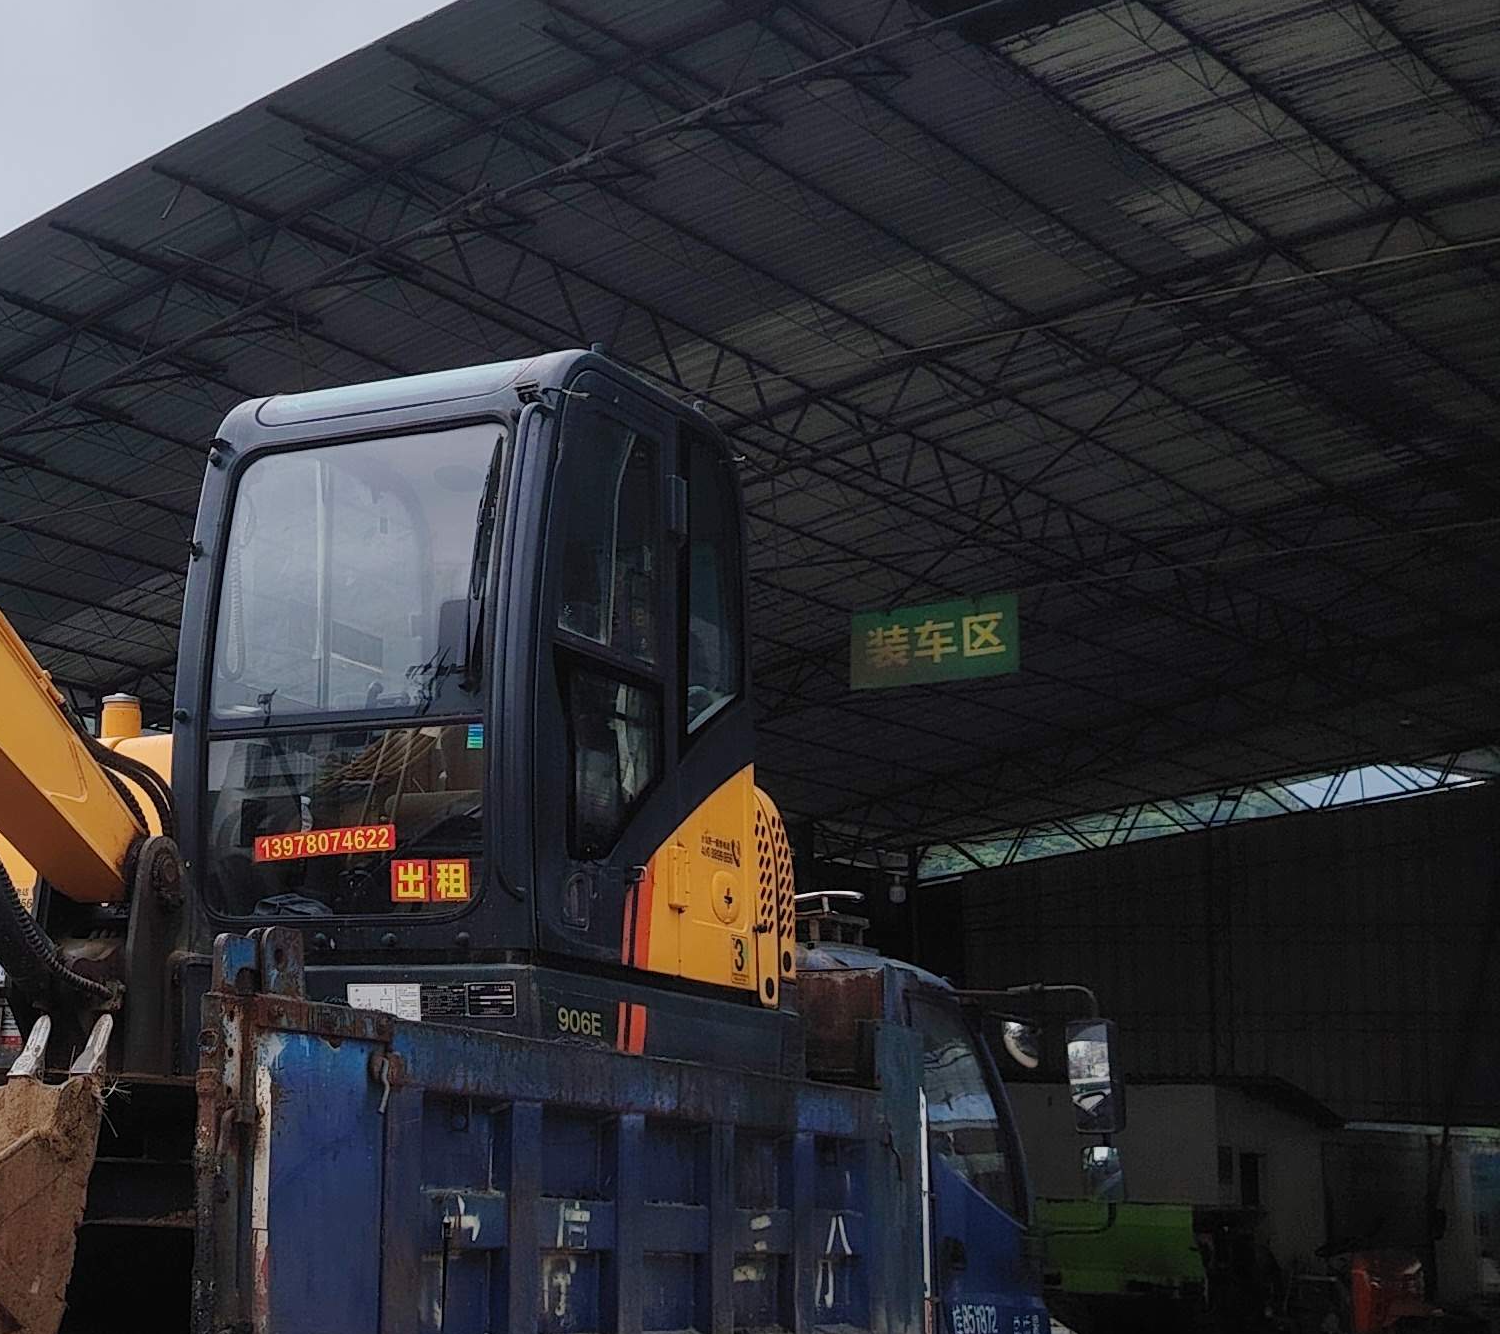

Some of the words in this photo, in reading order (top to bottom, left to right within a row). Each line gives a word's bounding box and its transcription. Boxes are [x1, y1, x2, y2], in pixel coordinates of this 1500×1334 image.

[866, 611, 1006, 668] 装车区
[260, 827, 390, 859] 13978074622
[397, 862, 468, 899] 出租
[557, 1006, 602, 1037] 906E
